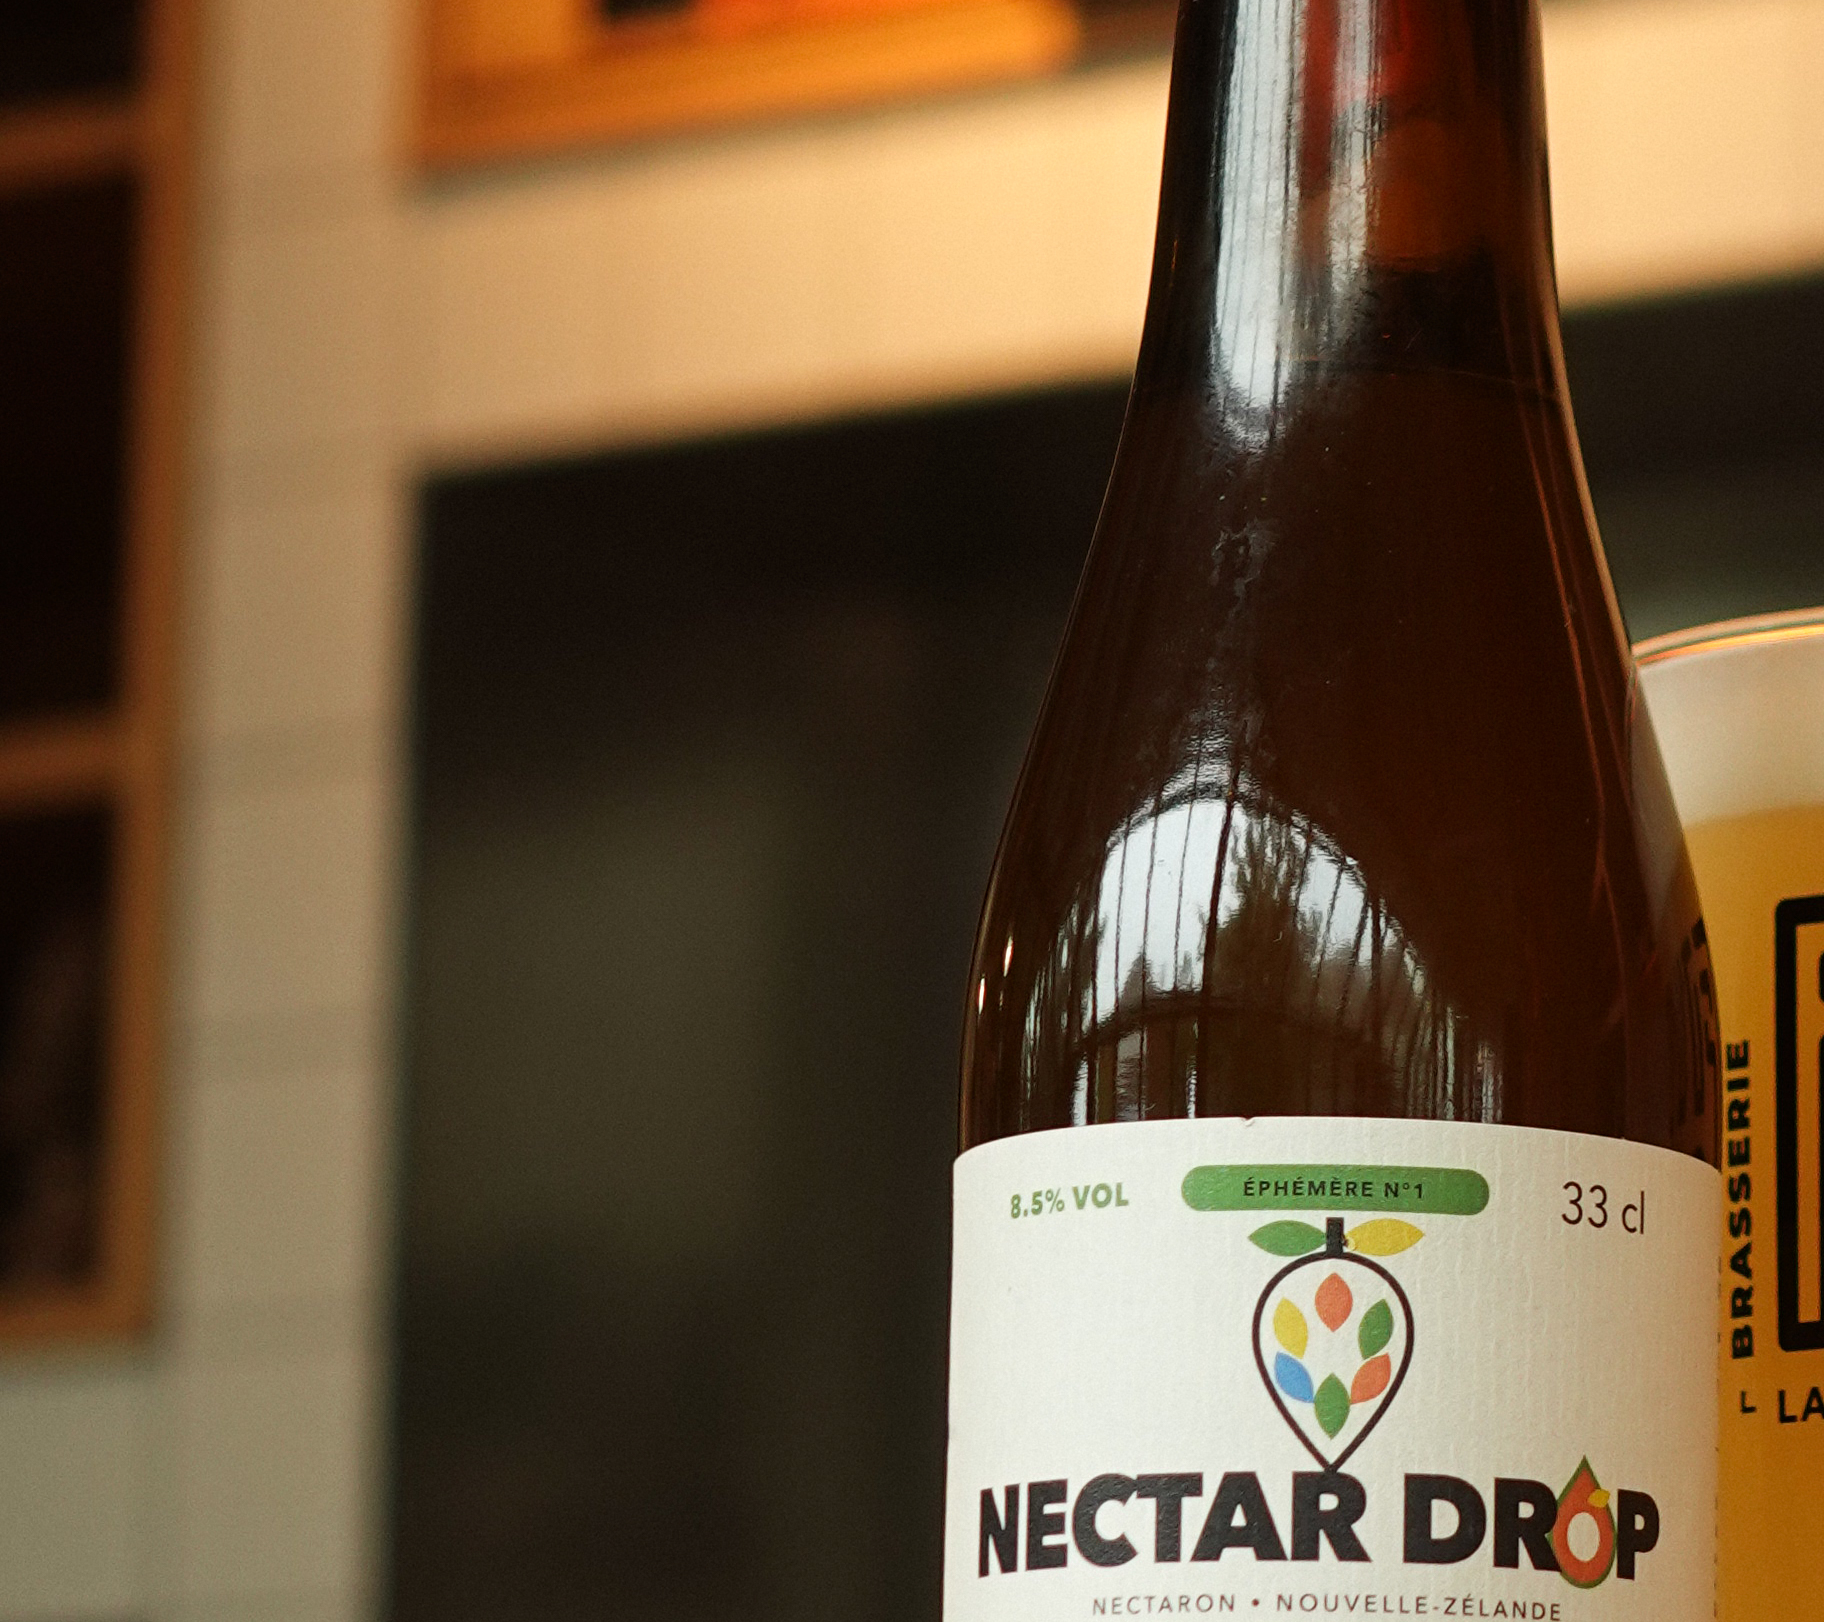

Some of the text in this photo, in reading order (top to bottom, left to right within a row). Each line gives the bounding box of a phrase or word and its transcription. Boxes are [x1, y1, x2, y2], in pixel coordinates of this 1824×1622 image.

[1010, 1182, 1130, 1220] 8.5% VOL
[1243, 1176, 1423, 1199] ÉPHÉMÈRE N°1
[1561, 1181, 1645, 1235] 33 cl
[1725, 1039, 1755, 1360] BRASSERIE
[978, 1455, 1662, 1590] NECTAR DROP
[1092, 1592, 1562, 1622] NECTARON NOUVELLE-ZÉLANDE
